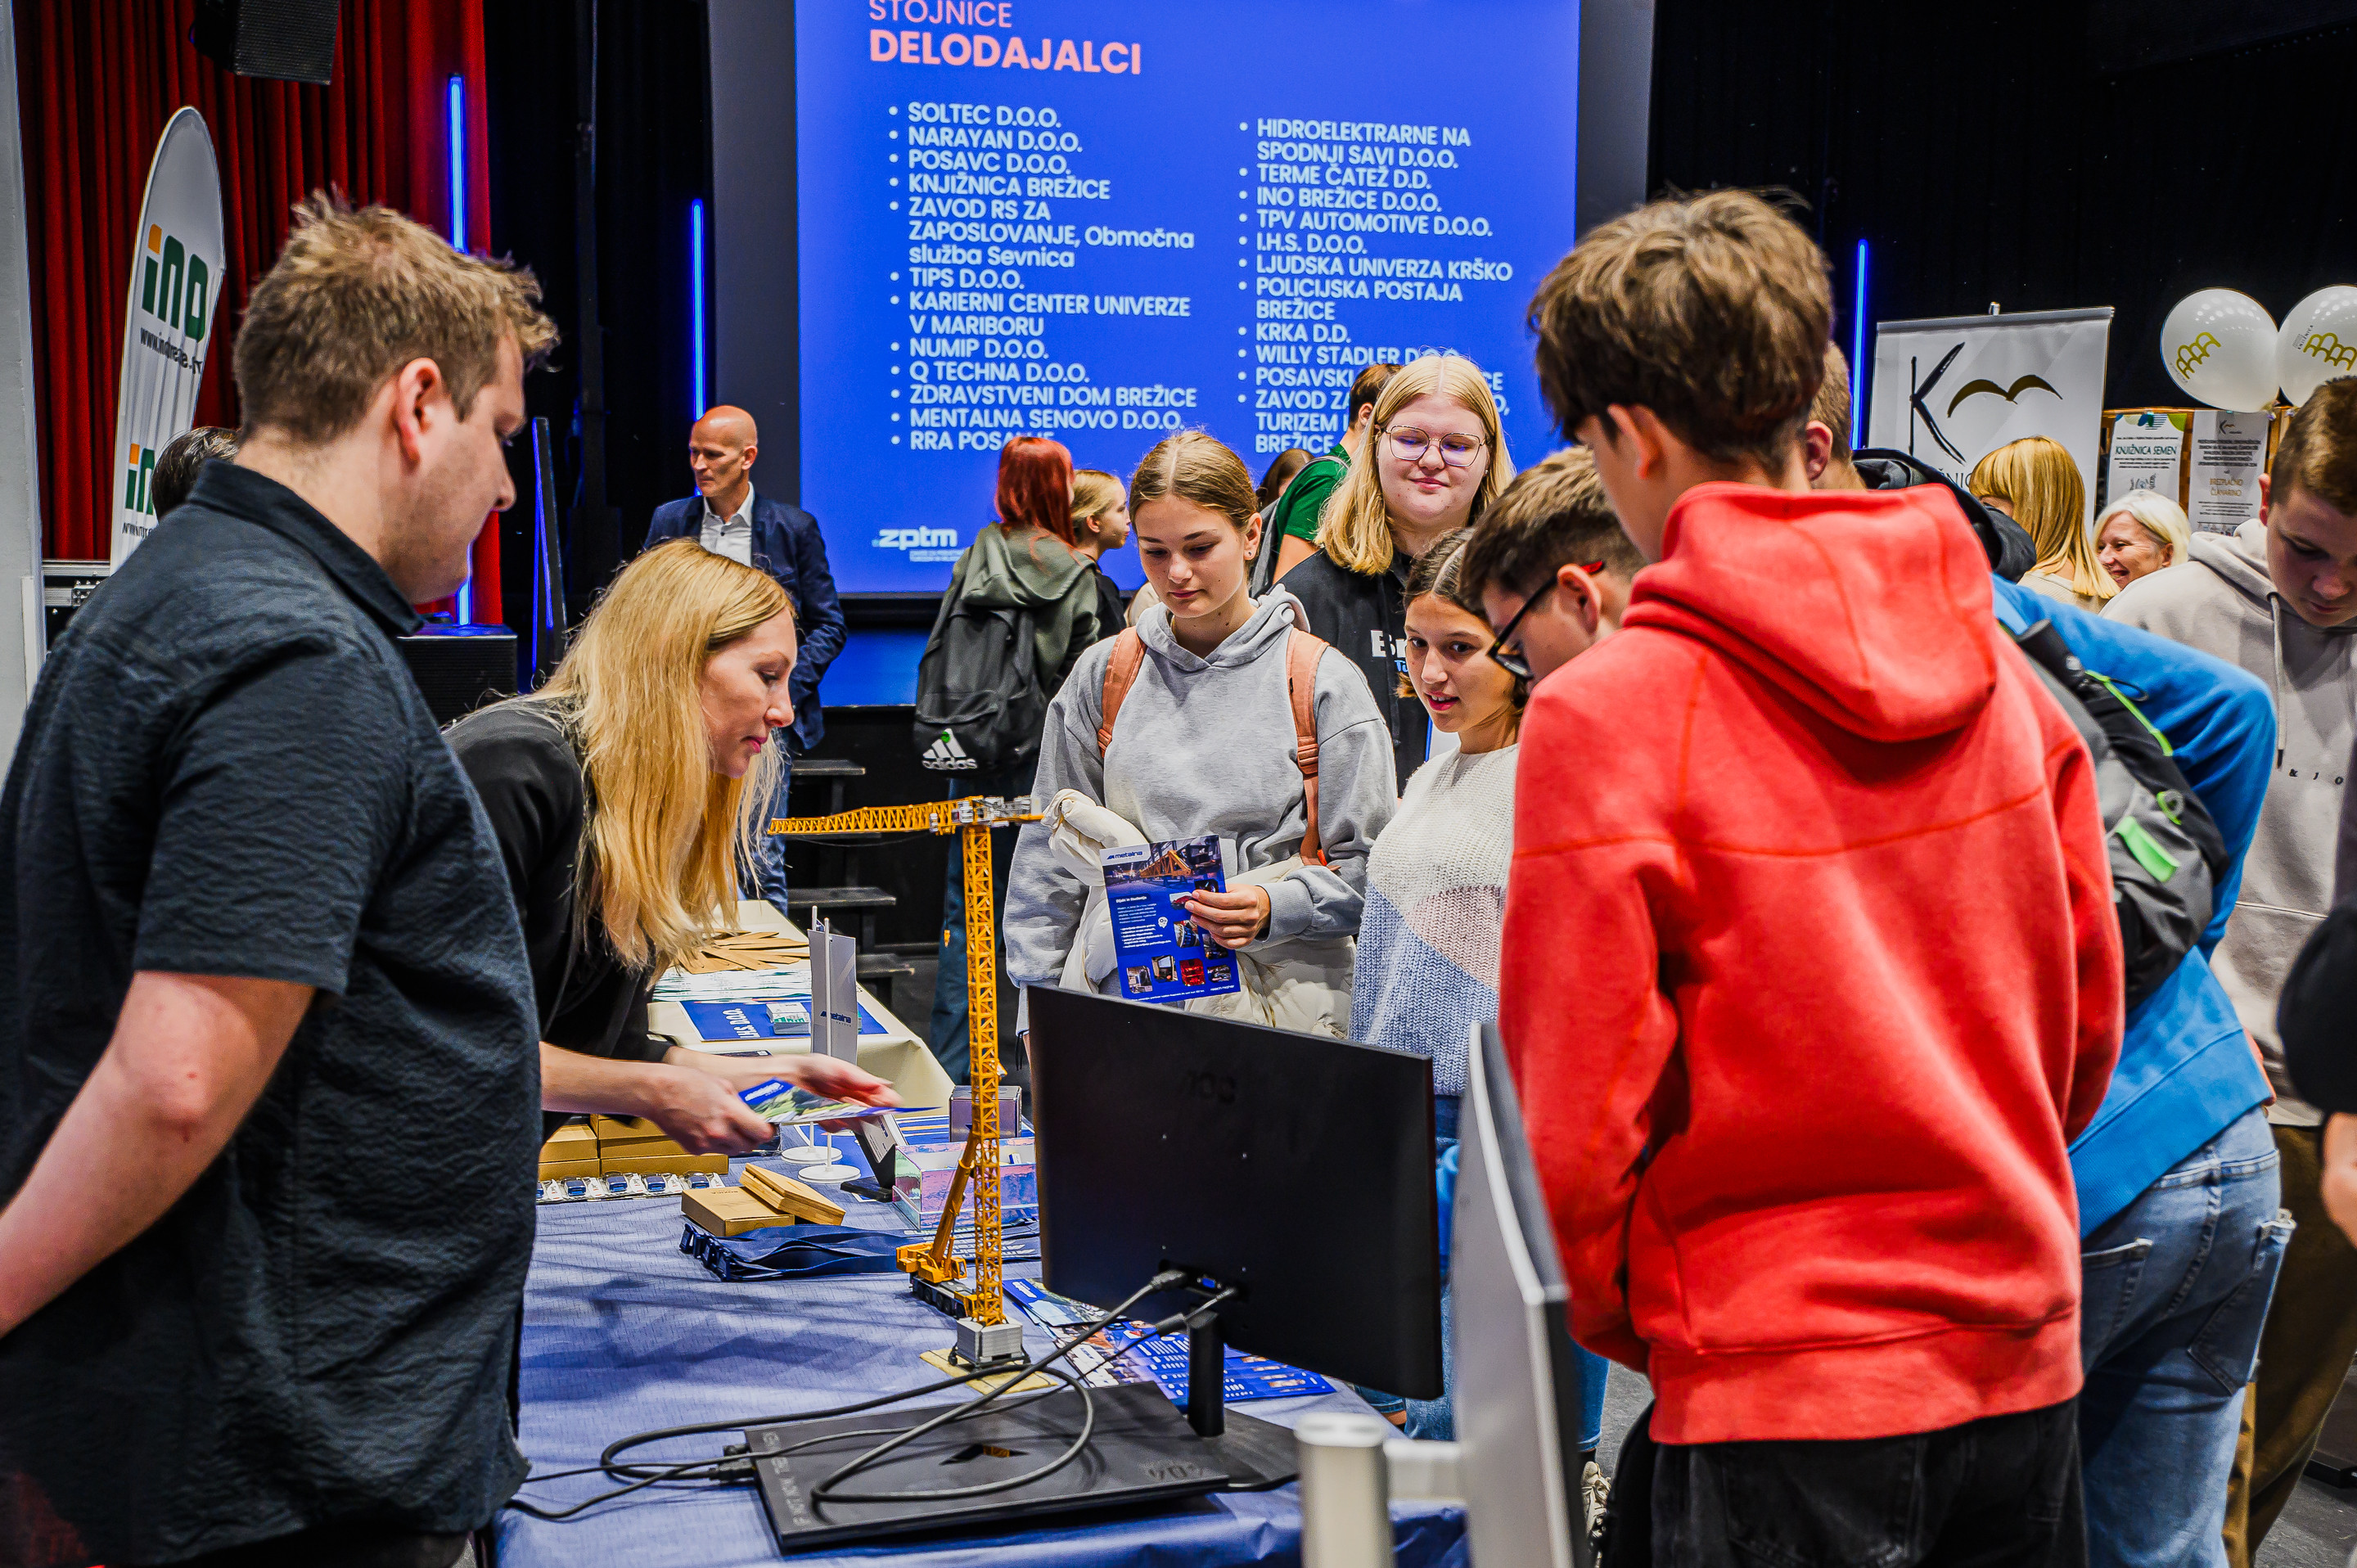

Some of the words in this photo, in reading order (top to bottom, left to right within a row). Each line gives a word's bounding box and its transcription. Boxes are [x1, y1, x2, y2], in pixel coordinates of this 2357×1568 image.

[870, 0, 1011, 27] STOJNICE
[871, 29, 1140, 74] DELODAJALCI
[908, 102, 990, 124] SOLTEC
[997, 106, 1061, 128] D.O.O.
[909, 126, 1012, 149] NARAYAN
[1019, 131, 1082, 152] D.O.O.
[1258, 119, 1437, 145] HIDROELEKTRARNE
[1443, 128, 1471, 146] NA
[909, 149, 1000, 171] POSAVC
[1007, 153, 1070, 174] D.O.O.
[1258, 142, 1343, 163] SPODNJI
[1349, 146, 1394, 165] SAVI
[1399, 147, 1458, 168] D.O.O.
[910, 172, 1021, 196] KNJIŽNICA
[1028, 176, 1110, 199] BREŽICE
[1257, 164, 1320, 184] TERME
[1326, 163, 1388, 187] ČATEŽ
[1394, 169, 1431, 189] D.D.
[909, 197, 985, 218] ZAVOD
[992, 200, 1018, 219] RS
[1024, 201, 1050, 220] ZA
[1258, 187, 1294, 206] INO
[1300, 187, 1377, 209] BREŽICE
[1383, 191, 1441, 212] D.O.O.
[1257, 209, 1295, 228] TPV
[1300, 212, 1428, 233] AUTOMOTIVE
[1434, 216, 1492, 236] D.O.O.
[909, 221, 1080, 248] ZAPOSLOVANJE,
[1085, 226, 1194, 248] Območna
[1257, 232, 1301, 251] I.H.S.
[1308, 233, 1367, 254] D.O.O.
[910, 244, 981, 264] služba
[988, 246, 1075, 267] Sevnica
[909, 268, 953, 287] TIPS
[960, 268, 1024, 289] D.O.O.
[1257, 255, 1344, 275] LJUDSKA
[1350, 258, 1443, 278] UNIVERZA
[1449, 258, 1512, 281] KRŠKO
[1257, 277, 1368, 298] POLICIJSKA
[1375, 281, 1462, 301] POSTAJA
[910, 291, 1003, 311] KARIERNI
[1009, 294, 1089, 313] CENTER
[1095, 295, 1190, 316] UNIVERZE
[1257, 298, 1335, 320] BREŽICE
[910, 315, 926, 333] V
[932, 316, 1043, 336] MARIBORU
[1257, 322, 1308, 341] KRKA
[1314, 324, 1350, 343] D.D.
[911, 338, 979, 357] NUMIP
[985, 339, 1048, 358] D.O.O.
[1255, 345, 1311, 363] WILLY
[1317, 346, 1399, 364] STADLER
[910, 361, 928, 383] Q
[935, 362, 1020, 381] TECHNA
[1026, 363, 1089, 382] D.O.O.
[1256, 367, 1354, 388] POSAVSKI
[911, 385, 1053, 404] ZDRAVSTVENI
[1060, 386, 1110, 405] DOM
[1116, 385, 1197, 407] BREŽICE
[1256, 390, 1326, 408] ZAVOD
[911, 408, 1023, 427] MENTALNA
[1030, 409, 1117, 429] SENOVO
[1123, 410, 1184, 431] D.O.O.
[1255, 412, 1337, 431] TURIZEM
[911, 430, 953, 449] RRA
[959, 431, 1054, 450] POSA
[1256, 432, 1333, 453] BREŽICE
[922, 757, 978, 770] adidas
